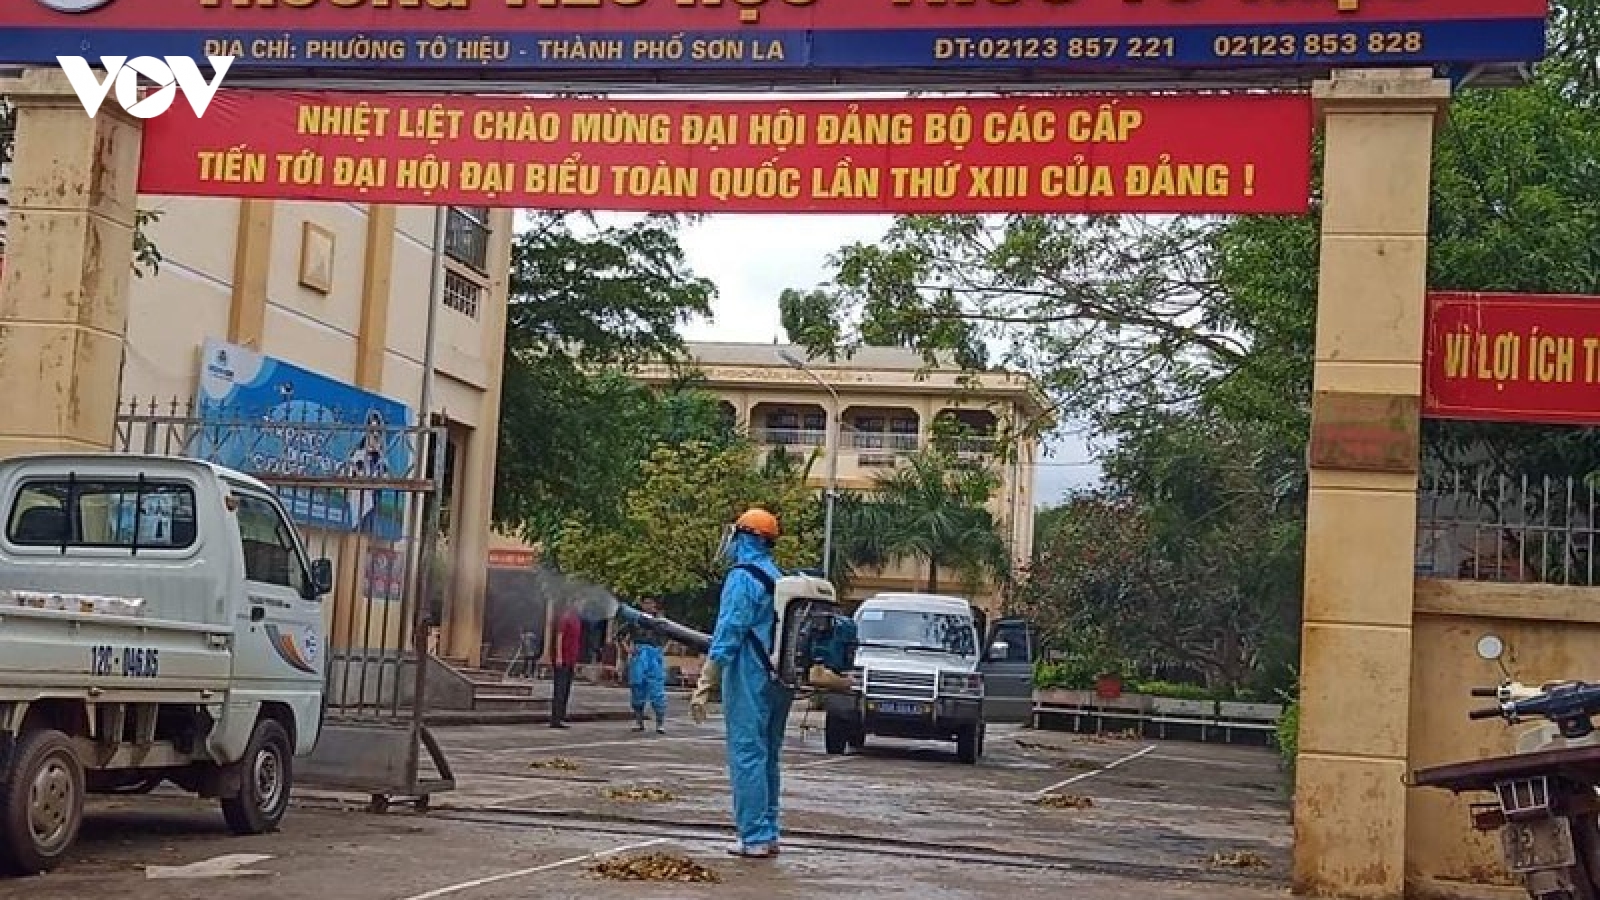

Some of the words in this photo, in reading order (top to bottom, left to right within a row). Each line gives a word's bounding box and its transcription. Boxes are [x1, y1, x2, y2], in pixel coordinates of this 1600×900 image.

[251, 33, 296, 59] CHỈ:
[306, 33, 405, 60] PHƯỜNG
[457, 35, 510, 64] HIỆU
[538, 34, 622, 60] THÀNH
[633, 32, 684, 60] PHỐ
[691, 38, 743, 60] SƠN
[751, 40, 784, 60] LA
[1067, 38, 1119, 58] 857
[1127, 37, 1175, 57] 221
[1214, 36, 1296, 56] 02123
[1303, 34, 1357, 54] 853
[1367, 32, 1421, 53] 828
[298, 101, 390, 143] NHIỆT
[473, 105, 561, 142] CHÀO
[571, 107, 671, 143] MỪNG
[681, 113, 739, 151] ĐẠI
[750, 107, 806, 152] HỘI
[816, 103, 913, 145] ĐẢNG
[925, 105, 972, 151] BỘ
[983, 105, 1056, 143] CÁC
[1067, 99, 1143, 142] CẤP
[198, 143, 267, 183] TIẾN
[276, 149, 325, 184] TỚI
[333, 157, 387, 193] ĐẠI
[396, 153, 451, 196] HỘI
[460, 161, 515, 198] ĐẠI
[525, 151, 600, 195] BIỂU
[611, 159, 699, 197] TOÀN
[709, 156, 801, 200] QUỐC
[811, 155, 880, 198] LẦN
[891, 160, 961, 198] THỨ
[967, 165, 1029, 197] XIII
[1041, 153, 1114, 197] CỦA
[1125, 153, 1230, 197] ĐẢNG
[1243, 163, 1255, 195] !
[1445, 323, 1471, 378] VÌ
[1477, 331, 1521, 391] LỢI
[1528, 325, 1575, 383] ÍCH
[1583, 338, 1600, 384] T
